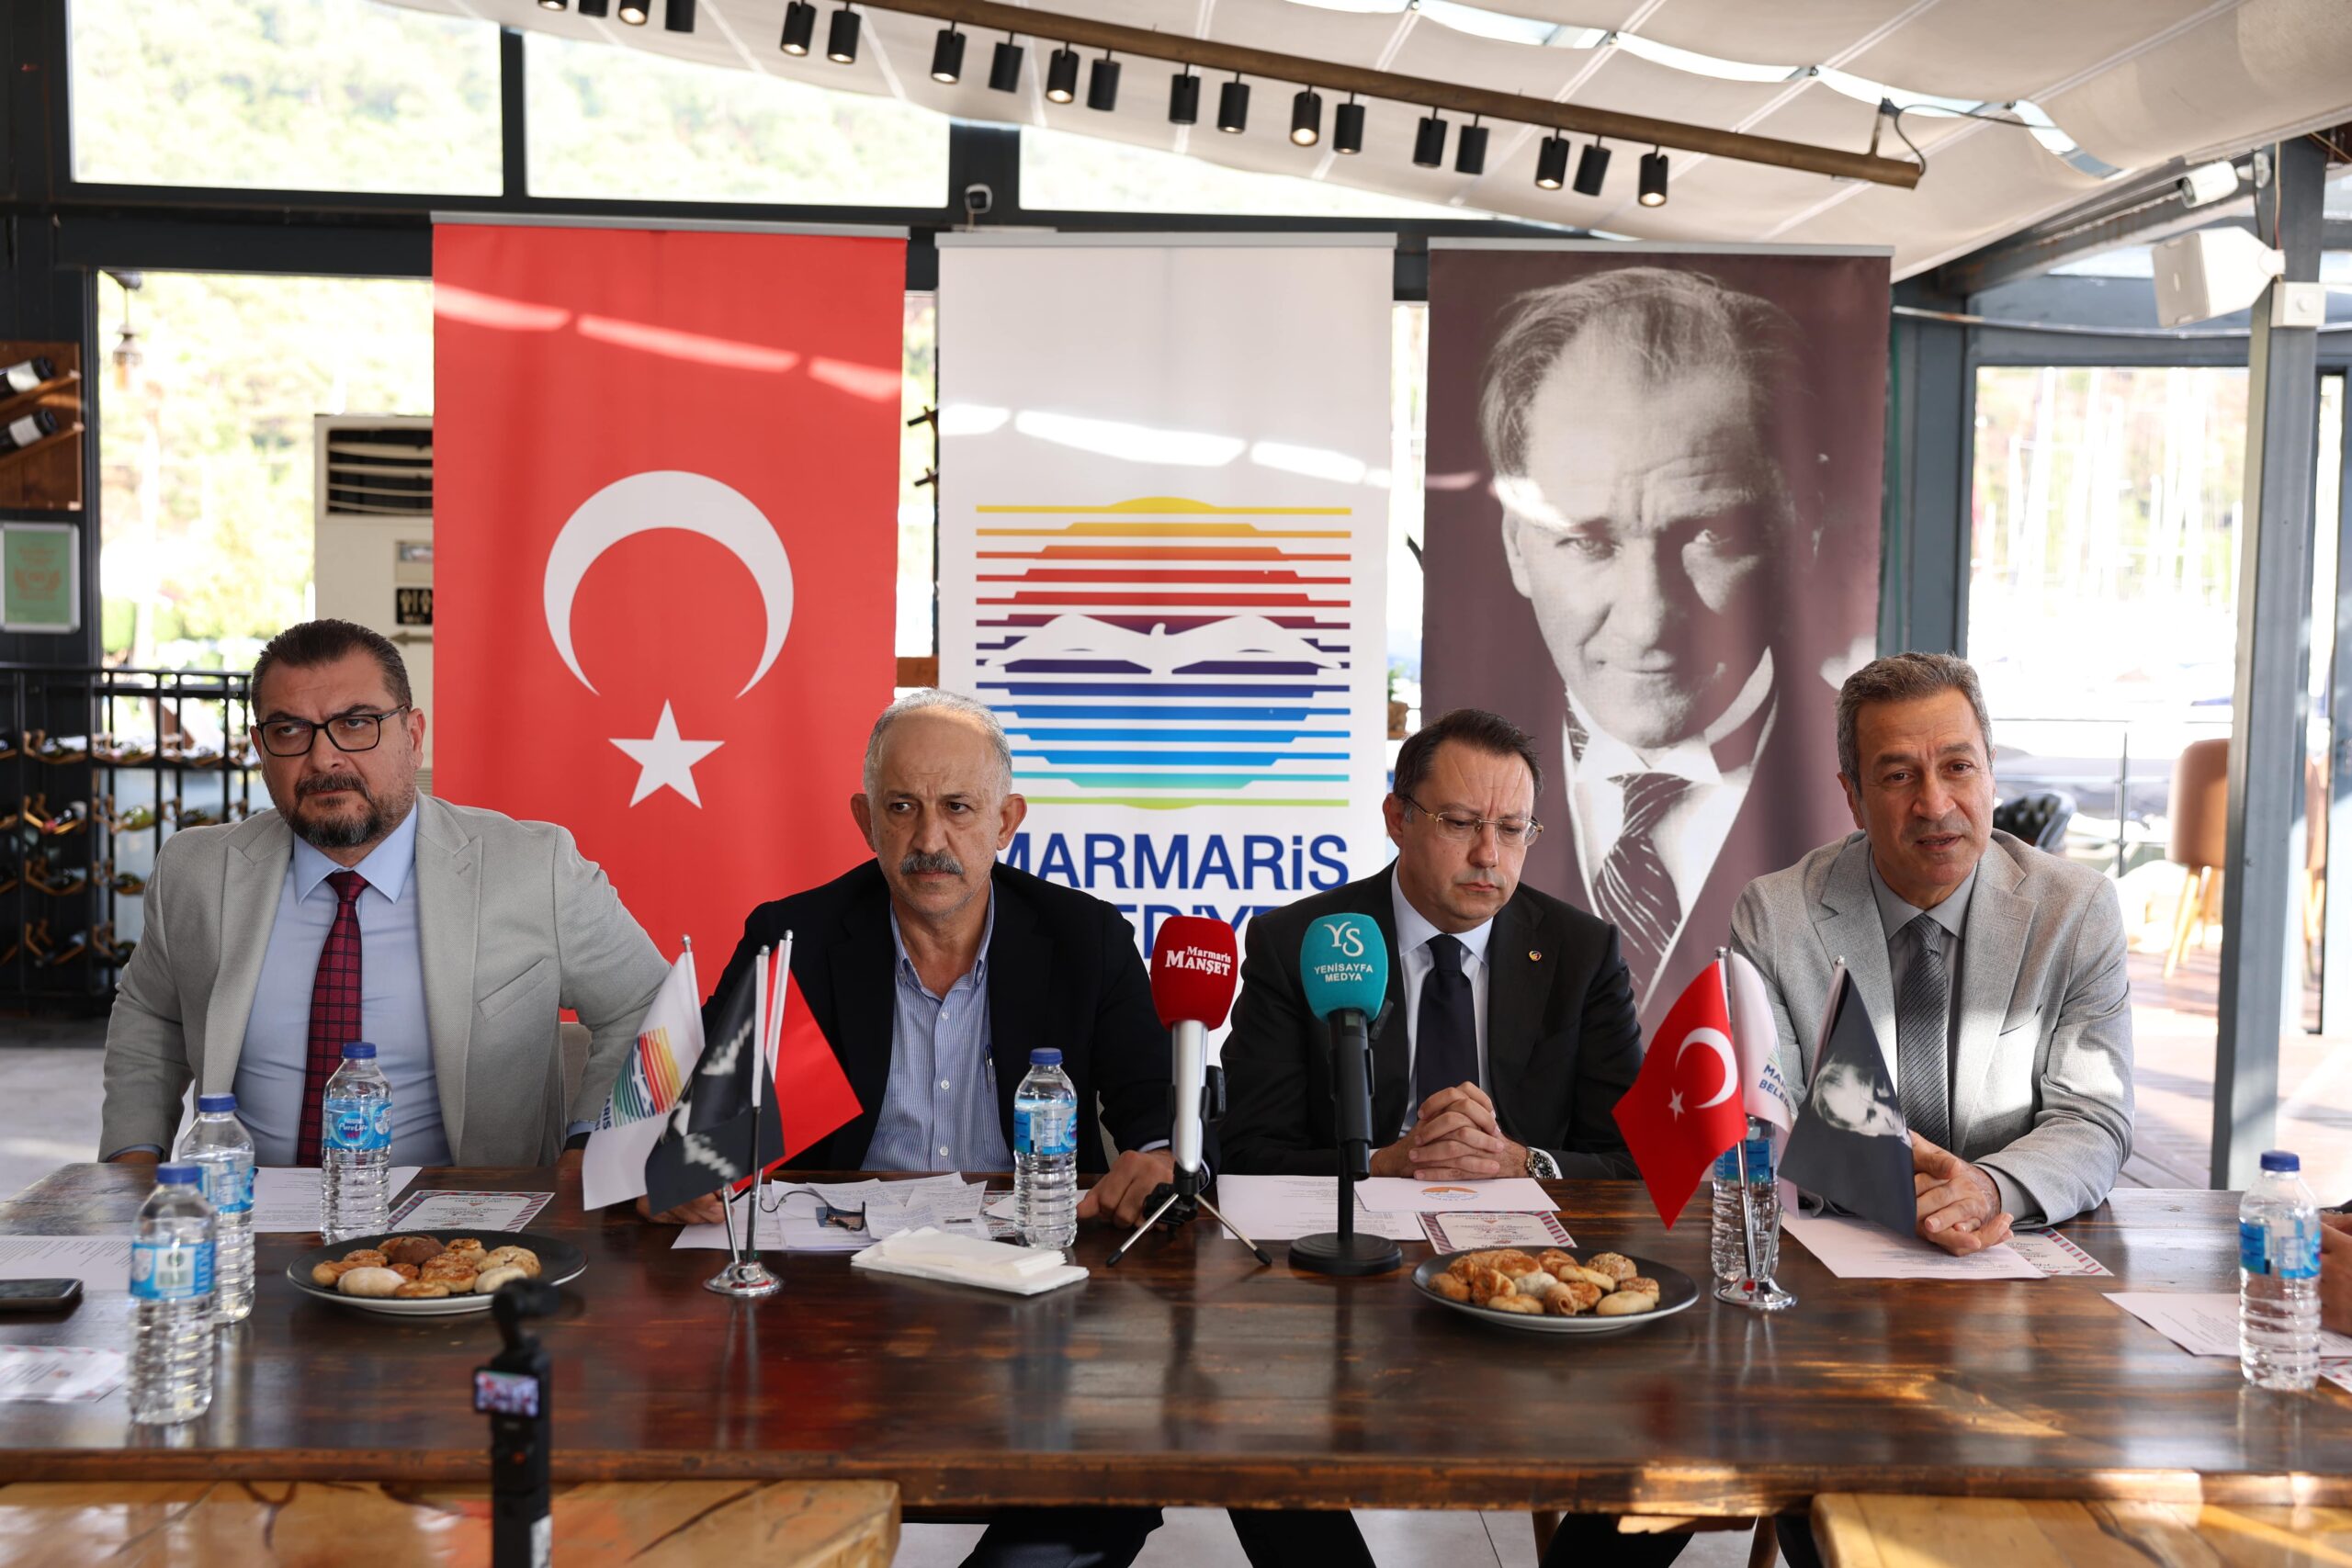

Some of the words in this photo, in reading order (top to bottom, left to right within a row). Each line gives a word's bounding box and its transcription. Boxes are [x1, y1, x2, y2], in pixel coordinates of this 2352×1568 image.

[1323, 921, 1364, 957] YS
[1164, 949, 1231, 976] MANŞET
[1186, 945, 1231, 964] Marmaris
[1314, 963, 1374, 975] YENİSAYFA
[1324, 973, 1363, 984] MEDYA
